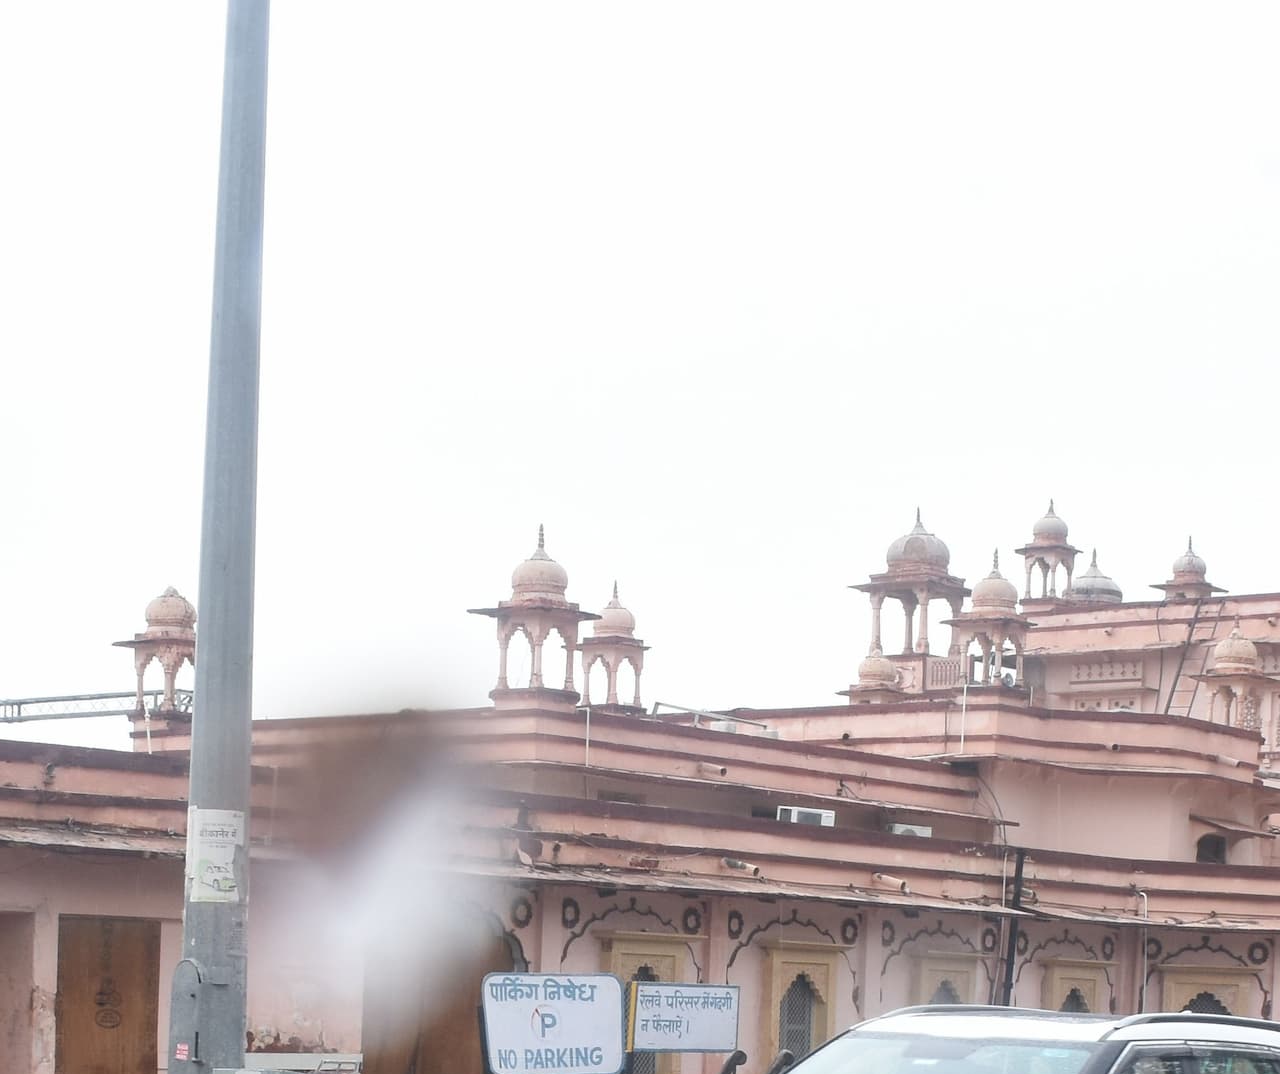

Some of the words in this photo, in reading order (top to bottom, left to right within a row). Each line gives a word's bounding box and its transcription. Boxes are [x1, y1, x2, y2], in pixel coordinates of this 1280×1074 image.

[489, 977, 539, 1003] पार्किंग
[543, 978, 597, 1003] निषेध
[640, 990, 662, 1009] रेलवे
[664, 990, 700, 1011] परिसर
[540, 1013, 557, 1038] P
[640, 1018, 650, 1032] न
[498, 1048, 518, 1070] NO
[524, 1047, 603, 1070] PARKING
